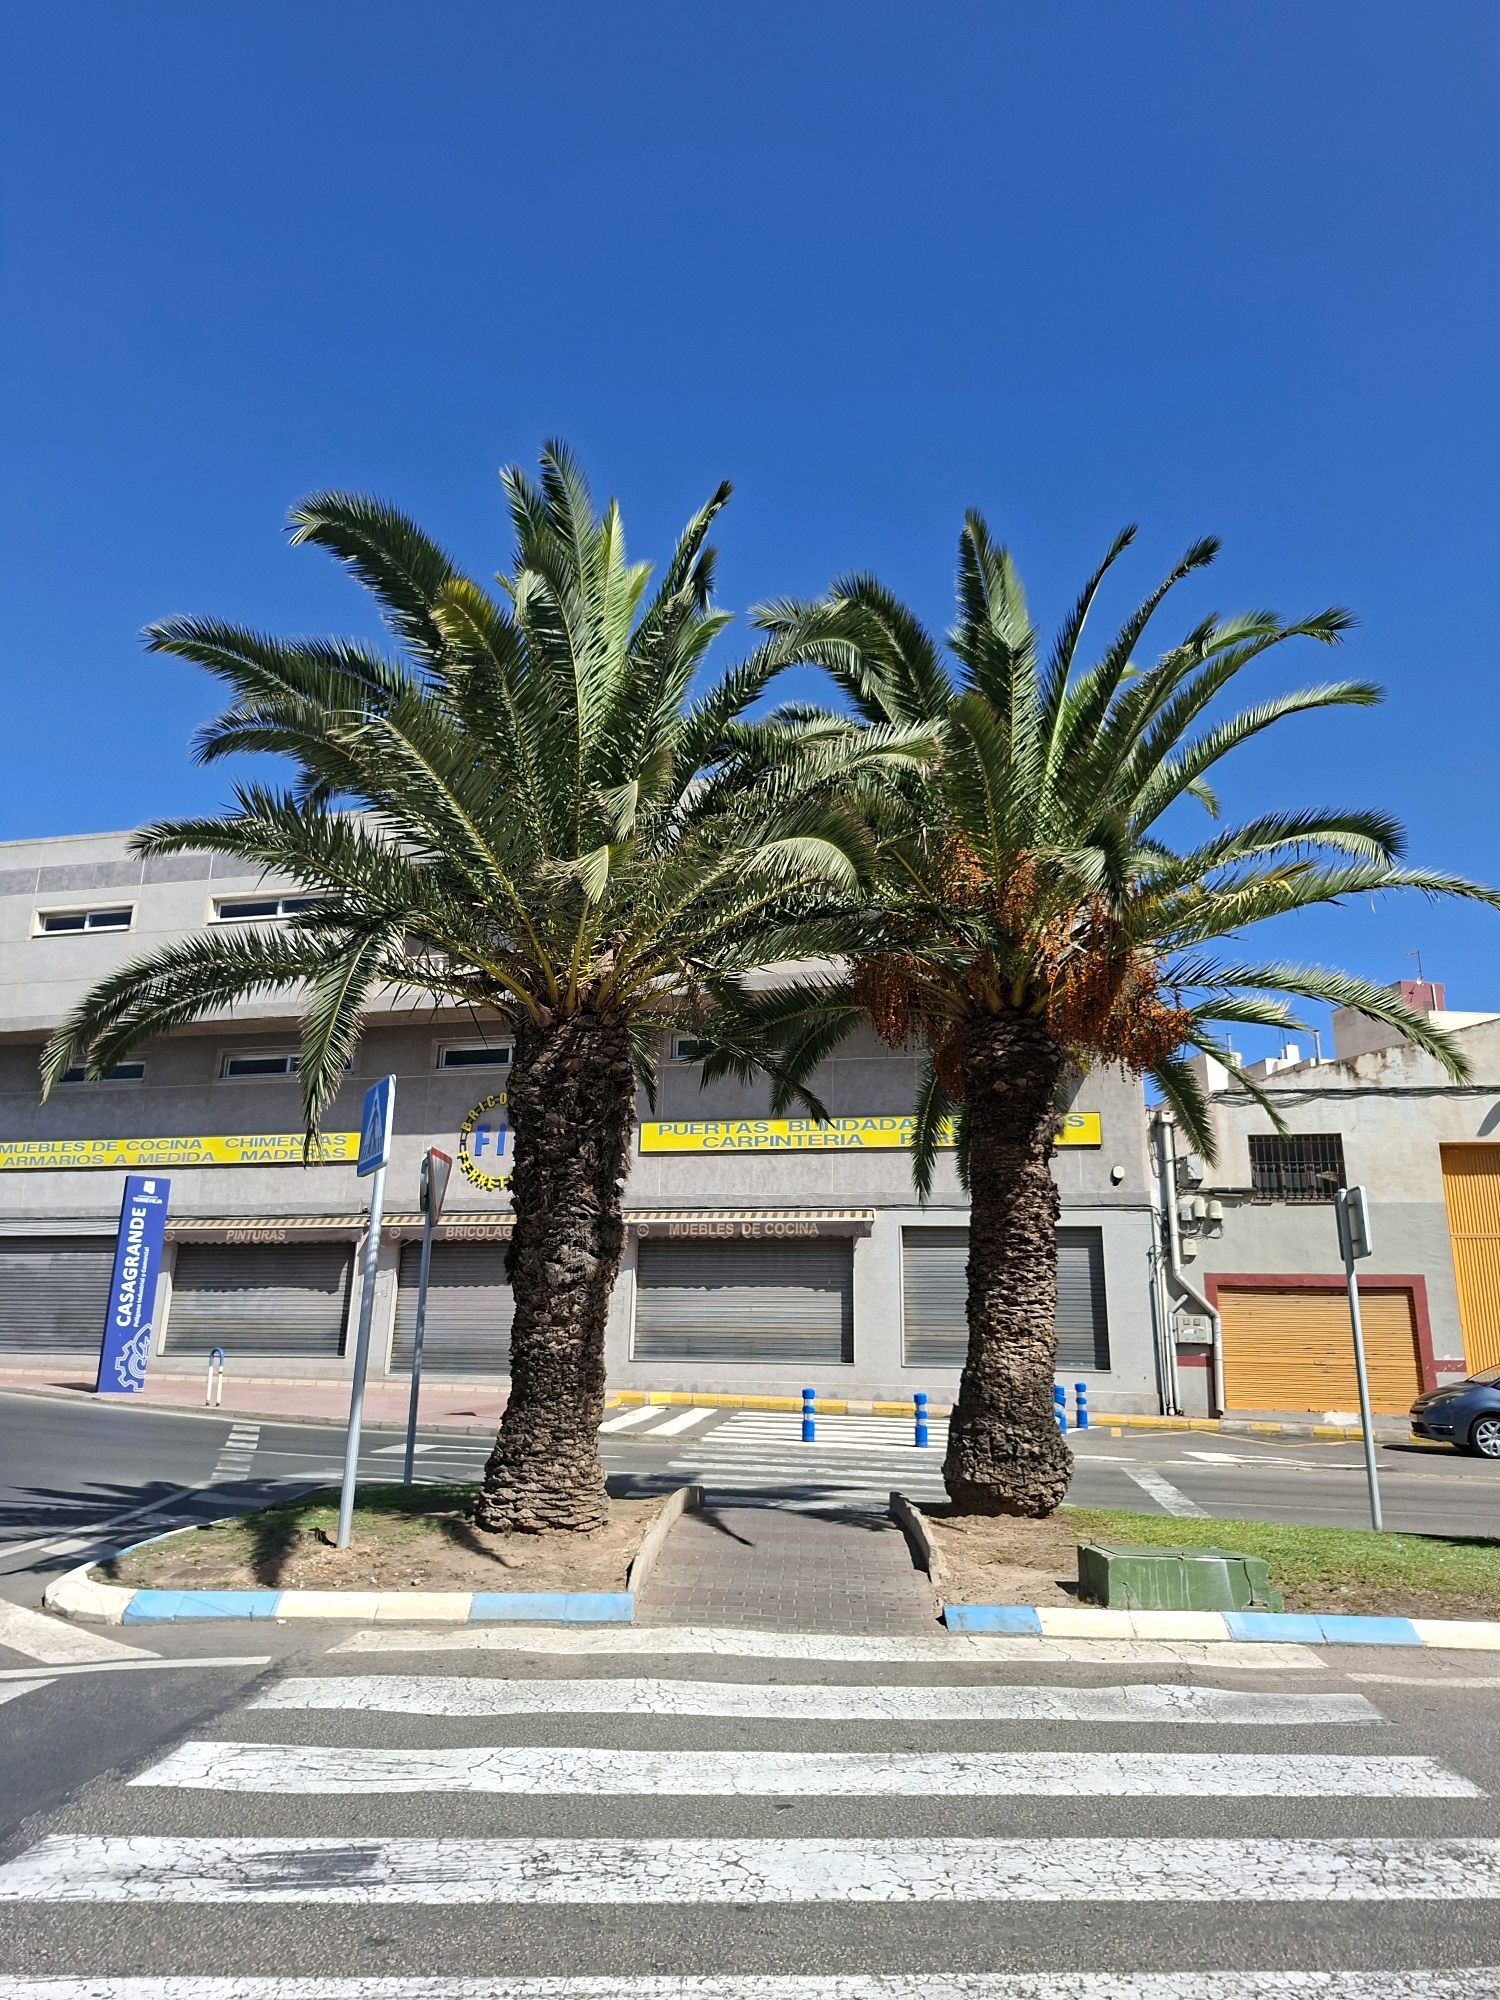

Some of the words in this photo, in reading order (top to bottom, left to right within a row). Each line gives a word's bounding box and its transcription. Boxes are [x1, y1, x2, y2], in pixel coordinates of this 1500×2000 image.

[658, 1122, 769, 1136] PUERTAS
[788, 1118, 916, 1132] BLINDADA
[0, 1141, 85, 1154] MUEBLES
[92, 1141, 118, 1152] DE
[126, 1138, 203, 1151] COCINA
[702, 1133, 864, 1148] CARPINTERIA
[3, 1154, 104, 1167] ARMARIOS
[113, 1153, 127, 1164] A
[138, 1151, 215, 1164] MEDIDA
[240, 1147, 346, 1161] MADERAS
[457, 1151, 513, 1191] FERRET
[226, 1229, 286, 1241] PINTURAS
[446, 1225, 512, 1237] BRICOLAG
[669, 1223, 734, 1236] MUEBLES
[742, 1223, 761, 1236] DE
[765, 1222, 819, 1235] COCINA
[116, 1207, 146, 1327] CASAGRANDE
